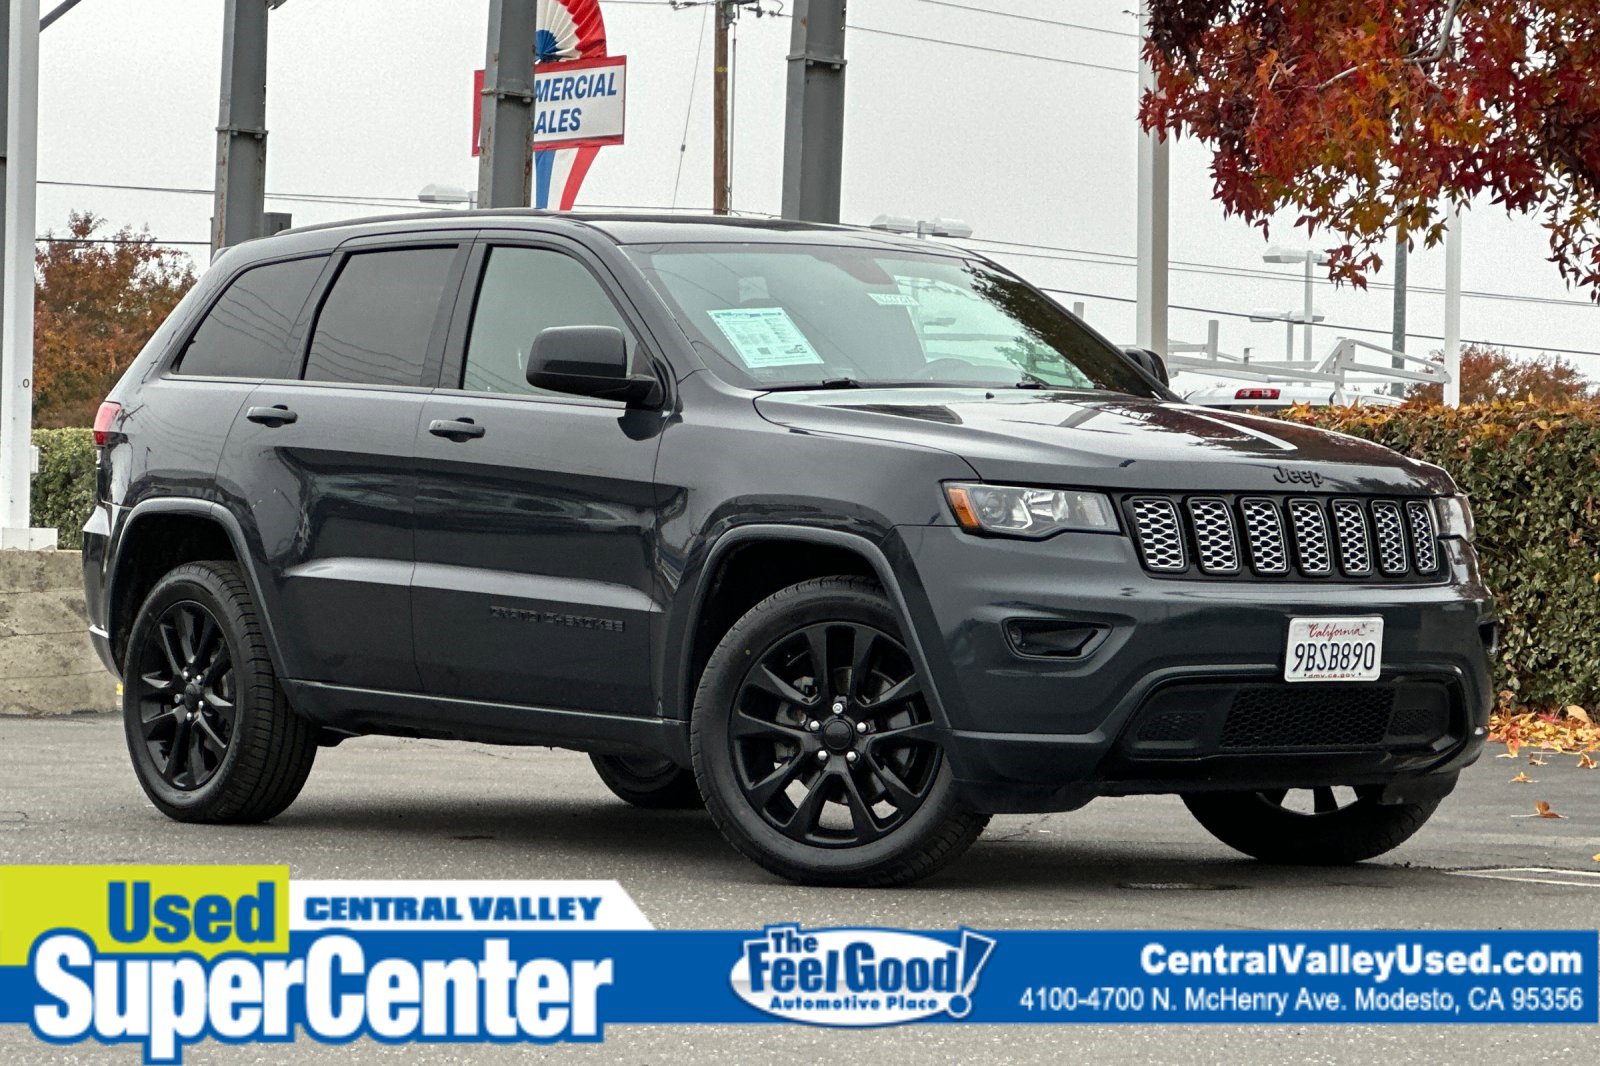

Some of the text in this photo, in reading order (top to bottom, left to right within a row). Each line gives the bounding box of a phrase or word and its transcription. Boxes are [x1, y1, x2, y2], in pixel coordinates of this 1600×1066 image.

[1273, 466, 1323, 488] Jeep
[1308, 623, 1365, 642] California
[1292, 642, 1376, 673] 9BSB890
